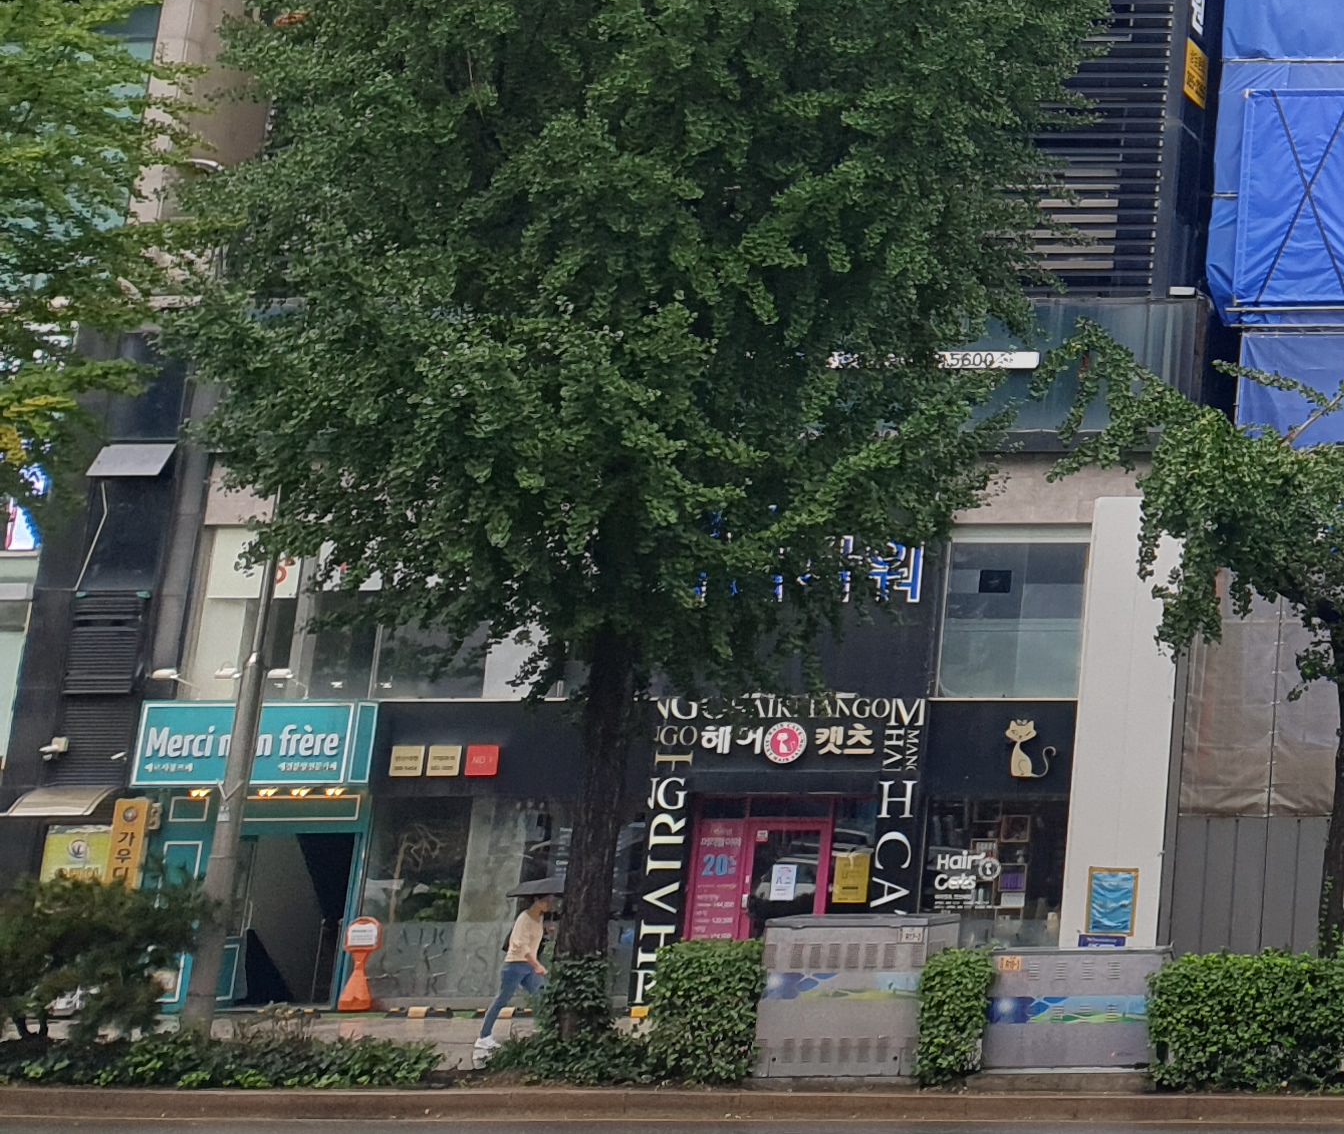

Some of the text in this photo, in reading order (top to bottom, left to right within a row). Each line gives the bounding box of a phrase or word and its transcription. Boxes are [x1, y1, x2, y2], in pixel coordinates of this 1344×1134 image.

[144, 725, 216, 759] Merci
[279, 724, 340, 758] frère
[815, 723, 876, 755] 캣츠
[936, 849, 986, 870] Hair
